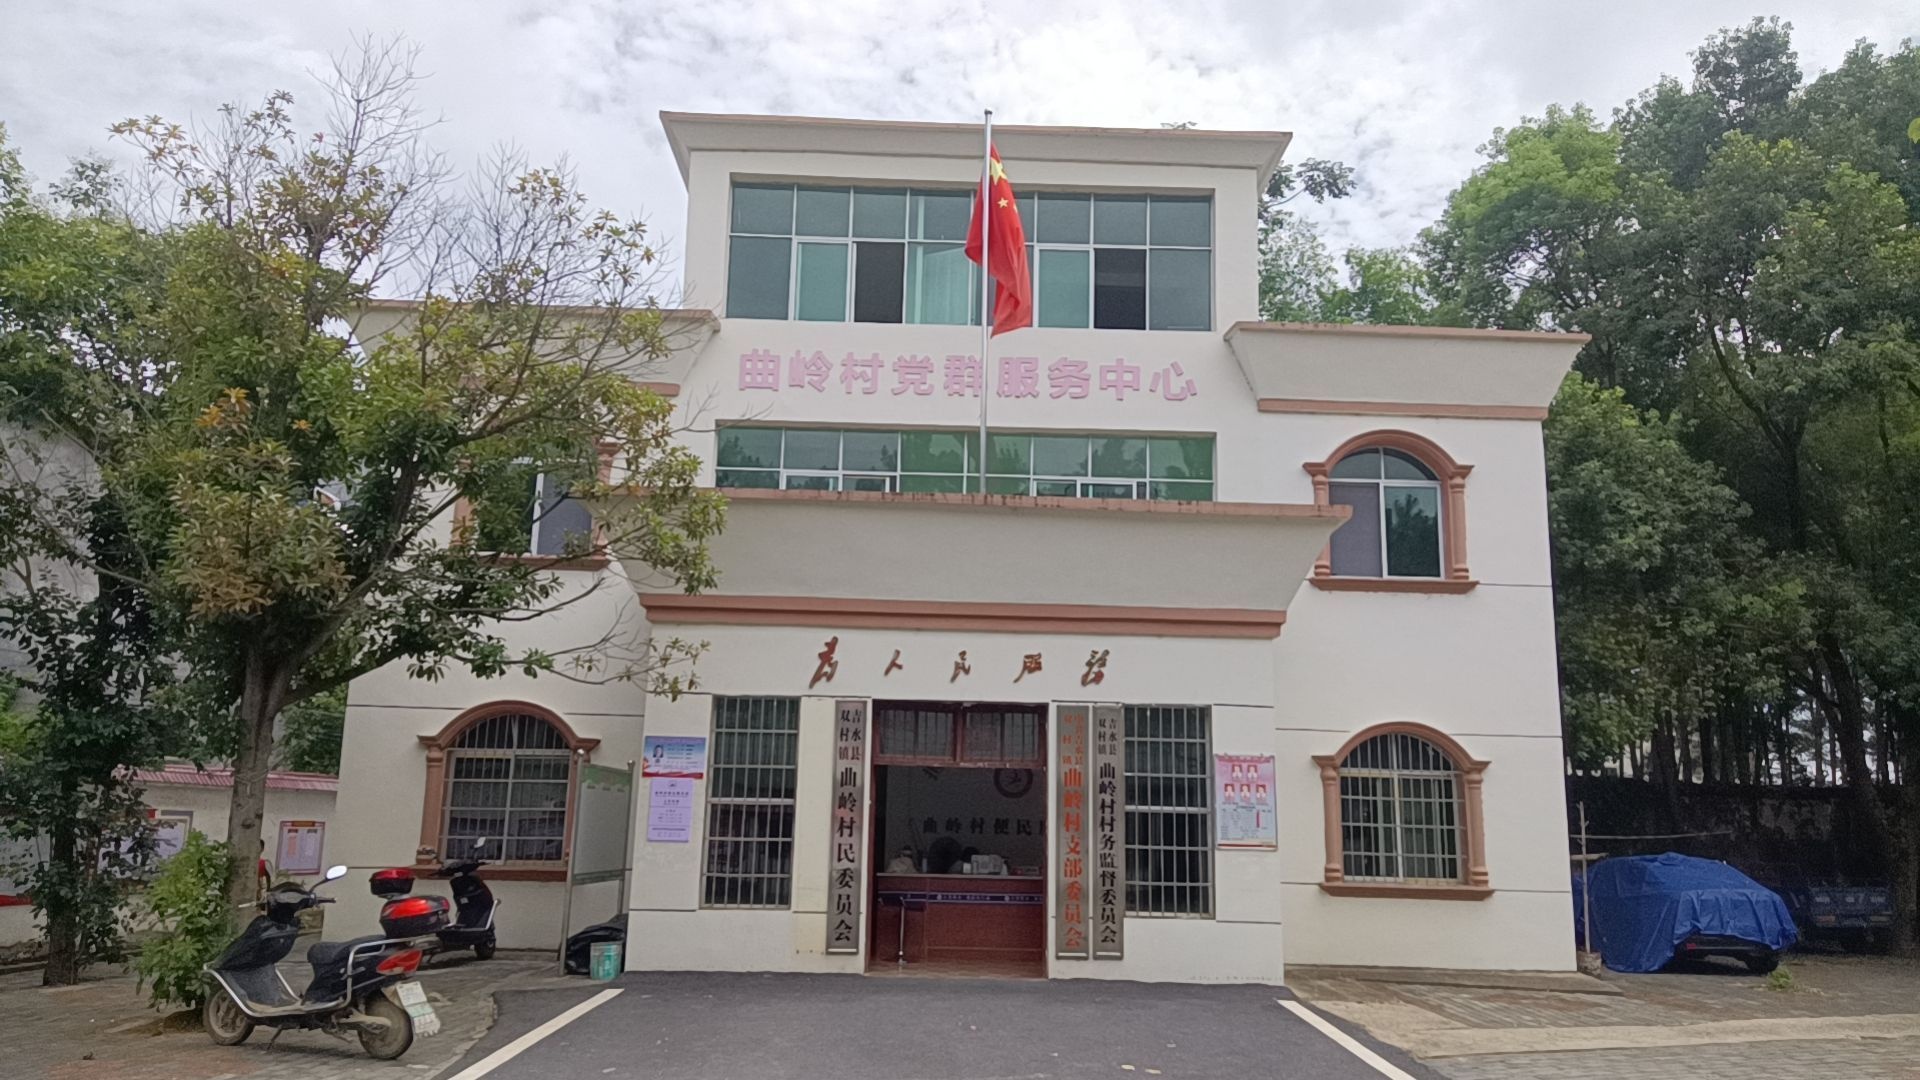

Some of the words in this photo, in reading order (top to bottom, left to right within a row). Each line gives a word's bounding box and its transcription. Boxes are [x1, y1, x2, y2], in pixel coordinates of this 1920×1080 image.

[738, 349, 1198, 401] 曲岭村党群服务中心
[851, 709, 861, 761] 吉水县
[834, 767, 858, 942] 曲岭村民委员会
[1063, 767, 1083, 948] 曲岭村支部委员会
[1098, 762, 1117, 944] 曲岭村村务监督委员会
